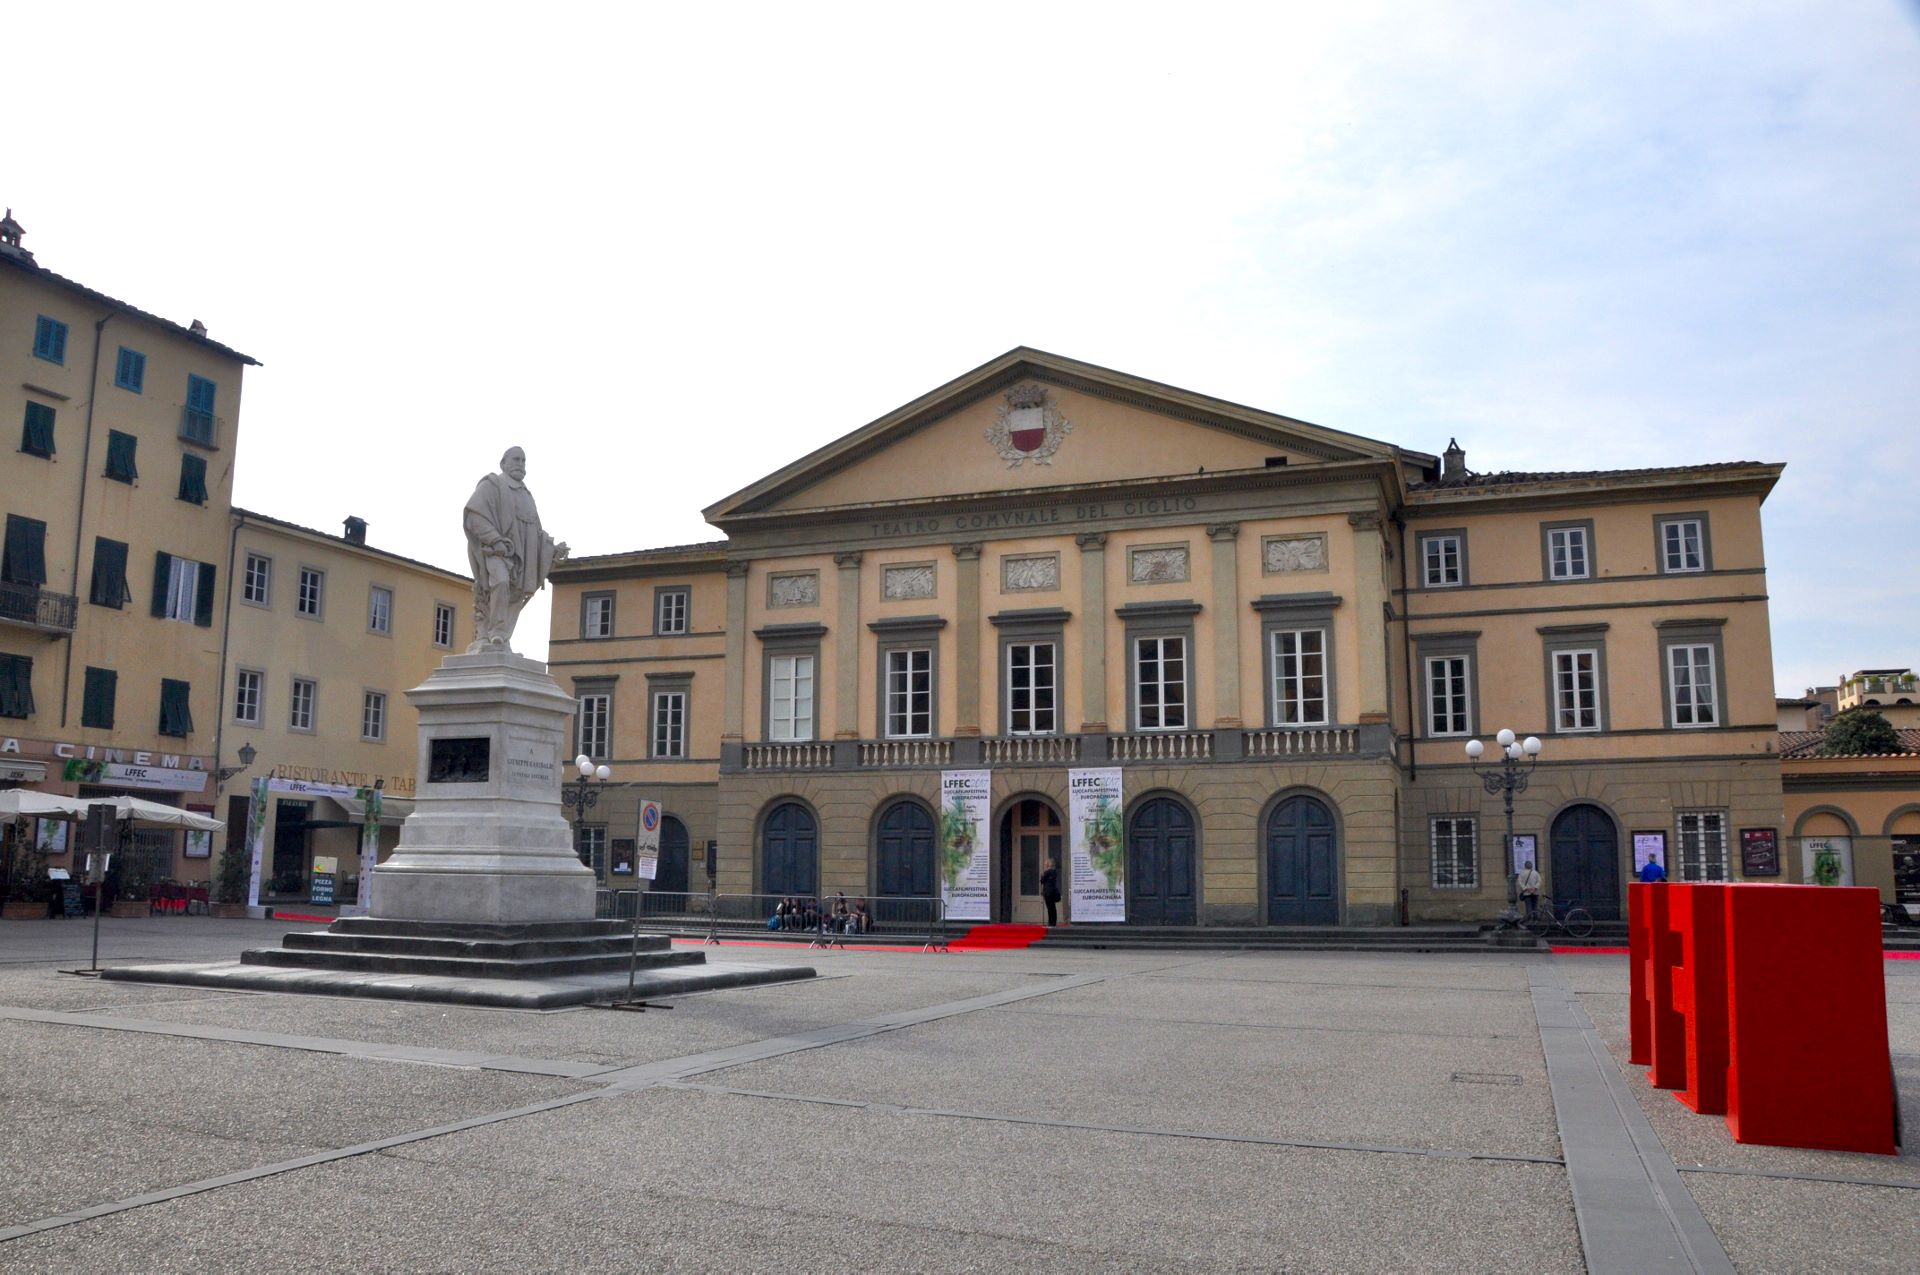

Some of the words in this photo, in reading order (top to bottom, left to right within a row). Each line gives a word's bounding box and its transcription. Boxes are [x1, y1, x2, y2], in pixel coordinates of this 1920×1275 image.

[871, 519, 940, 537] TEATRO
[956, 507, 1060, 530] COMVNALE
[1076, 504, 1110, 520] DEL
[1124, 499, 1198, 516] GIGLIO
[54, 743, 205, 771] CINEMA
[125, 768, 147, 778] LFFEC
[278, 764, 368, 787] RISTORANTE
[944, 779, 971, 788] LFFEC
[1072, 777, 1101, 787] LFFEC
[290, 783, 306, 792] LFFEC
[312, 885, 334, 893] FORNO
